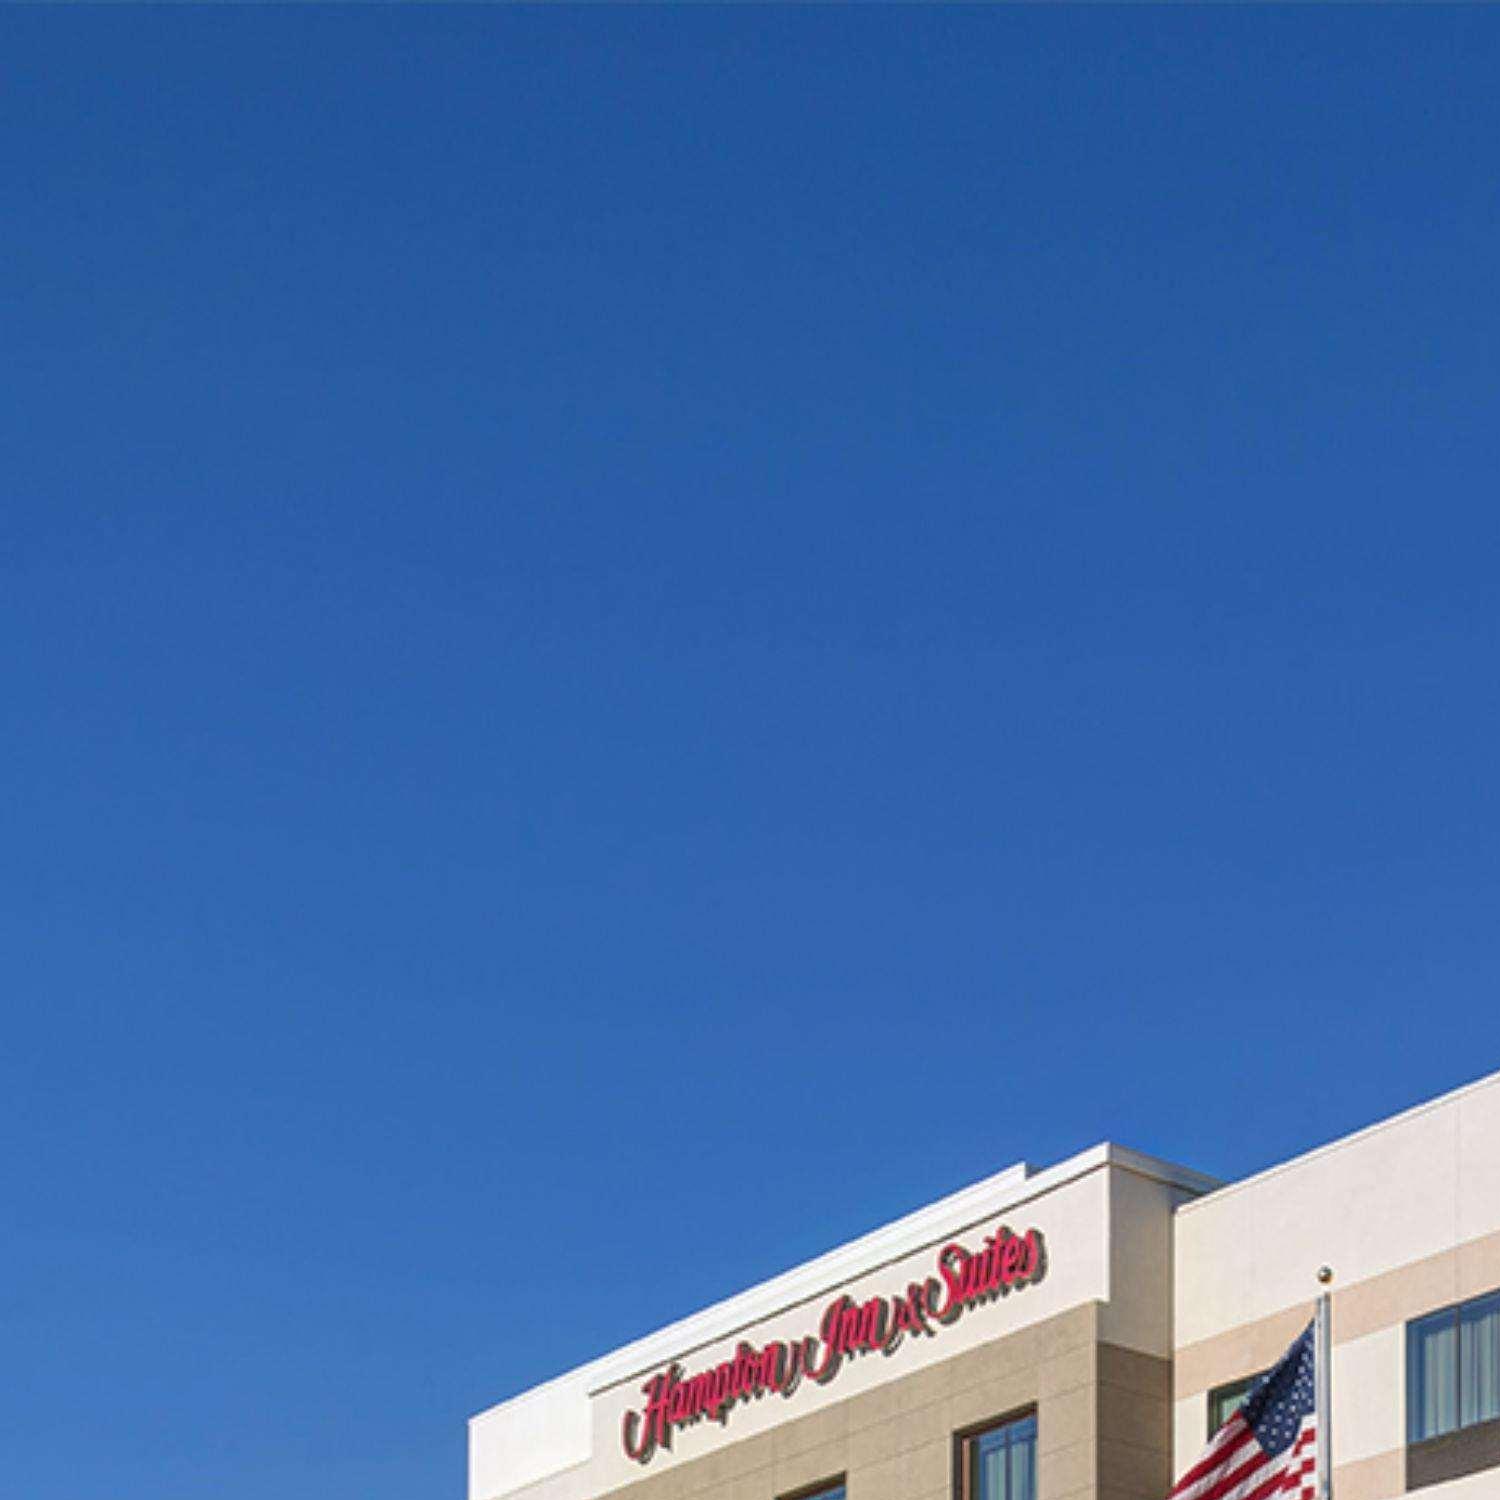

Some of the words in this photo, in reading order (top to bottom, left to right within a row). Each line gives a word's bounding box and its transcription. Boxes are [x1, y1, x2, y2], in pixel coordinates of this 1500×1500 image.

[623, 1341, 800, 1464] Hampton
[801, 1294, 899, 1385] Inn
[895, 1282, 936, 1337] &
[924, 1224, 1048, 1325] Suites
